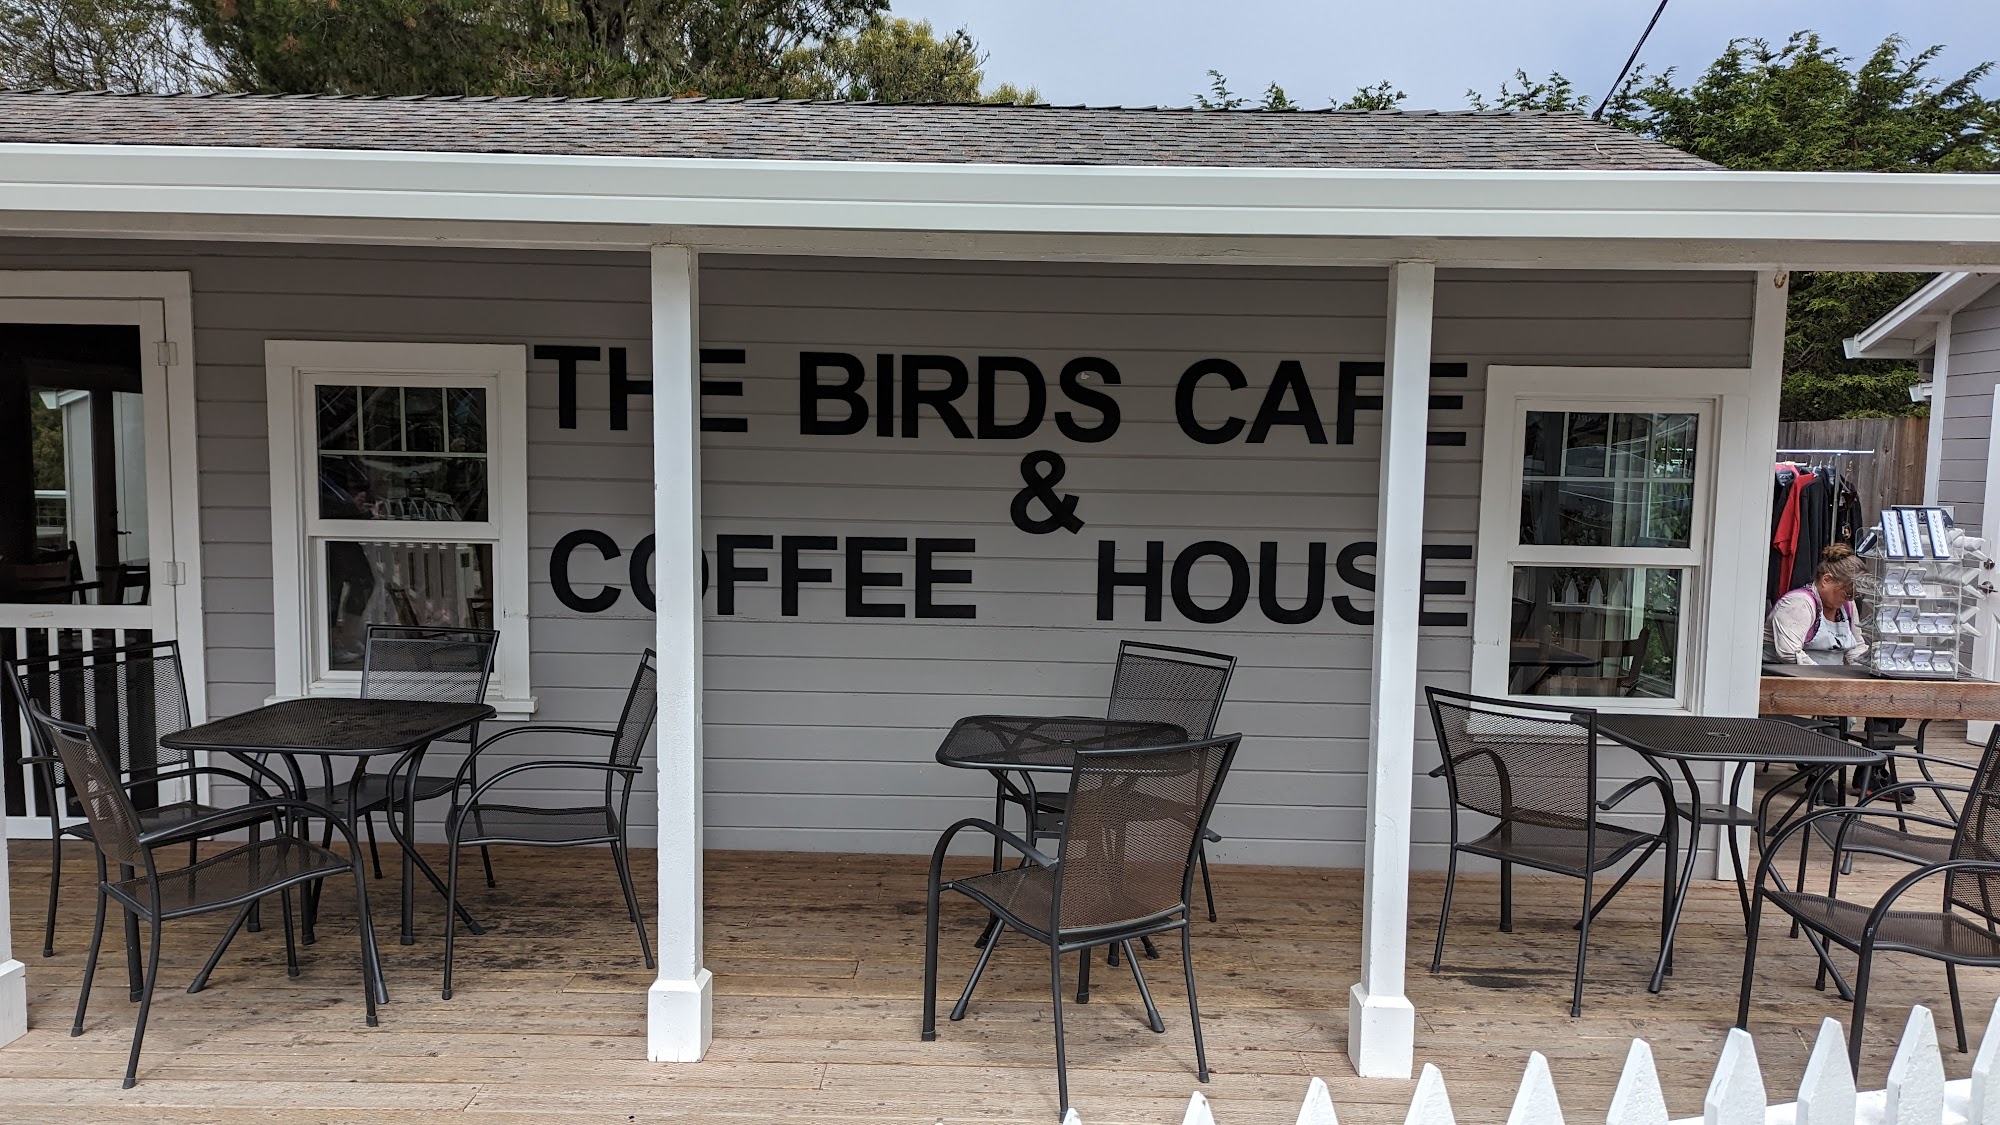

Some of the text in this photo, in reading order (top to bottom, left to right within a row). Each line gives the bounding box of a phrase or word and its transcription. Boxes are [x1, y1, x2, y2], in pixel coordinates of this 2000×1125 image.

[534, 345, 1468, 446] THE BIRDS CAFE
[1010, 450, 1085, 535] &
[1097, 540, 1473, 627] HOUSE
